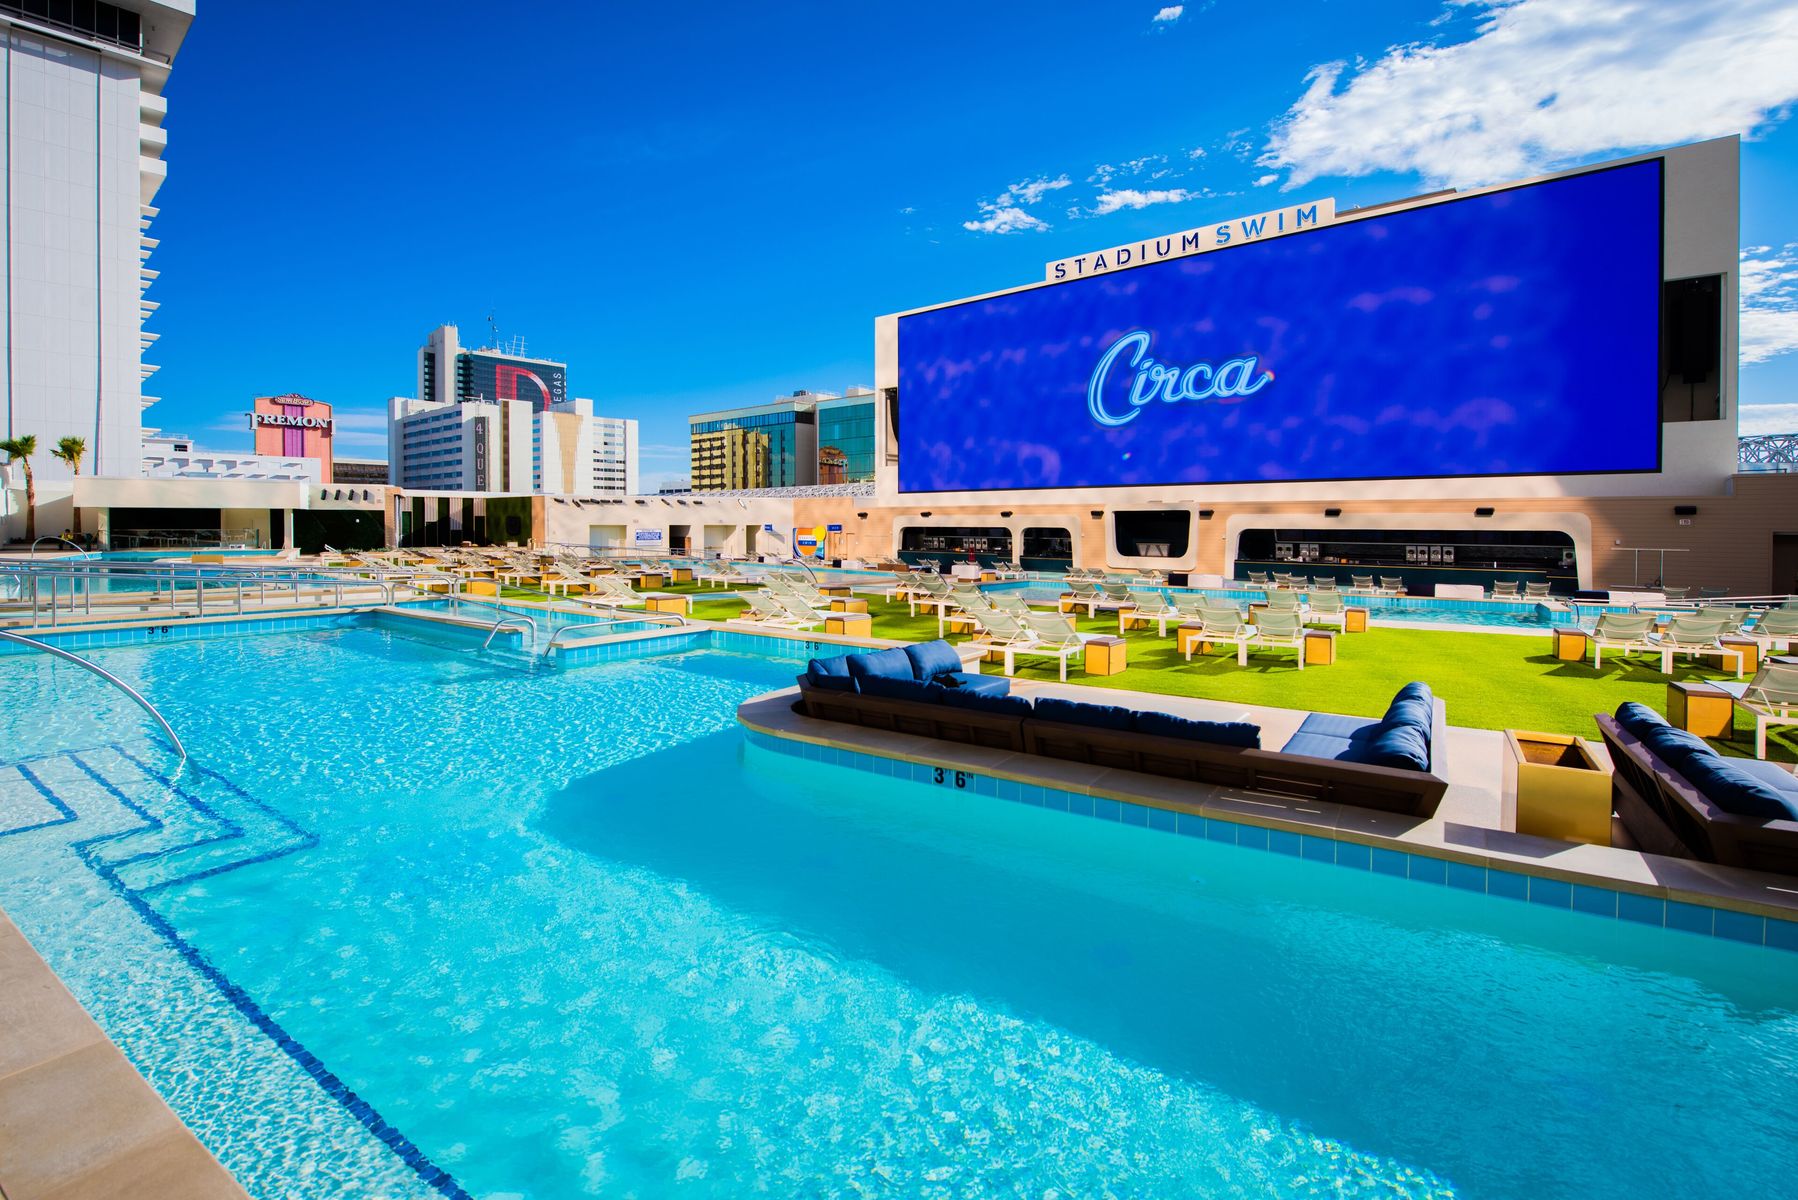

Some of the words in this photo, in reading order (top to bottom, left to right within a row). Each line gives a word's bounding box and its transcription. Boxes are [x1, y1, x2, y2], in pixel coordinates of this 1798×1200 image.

[1054, 232, 1200, 280] STADIUM
[1215, 204, 1318, 245] SWIM
[1087, 330, 1274, 427] Circa
[245, 412, 337, 435] FREMONT
[475, 422, 484, 435] 4
